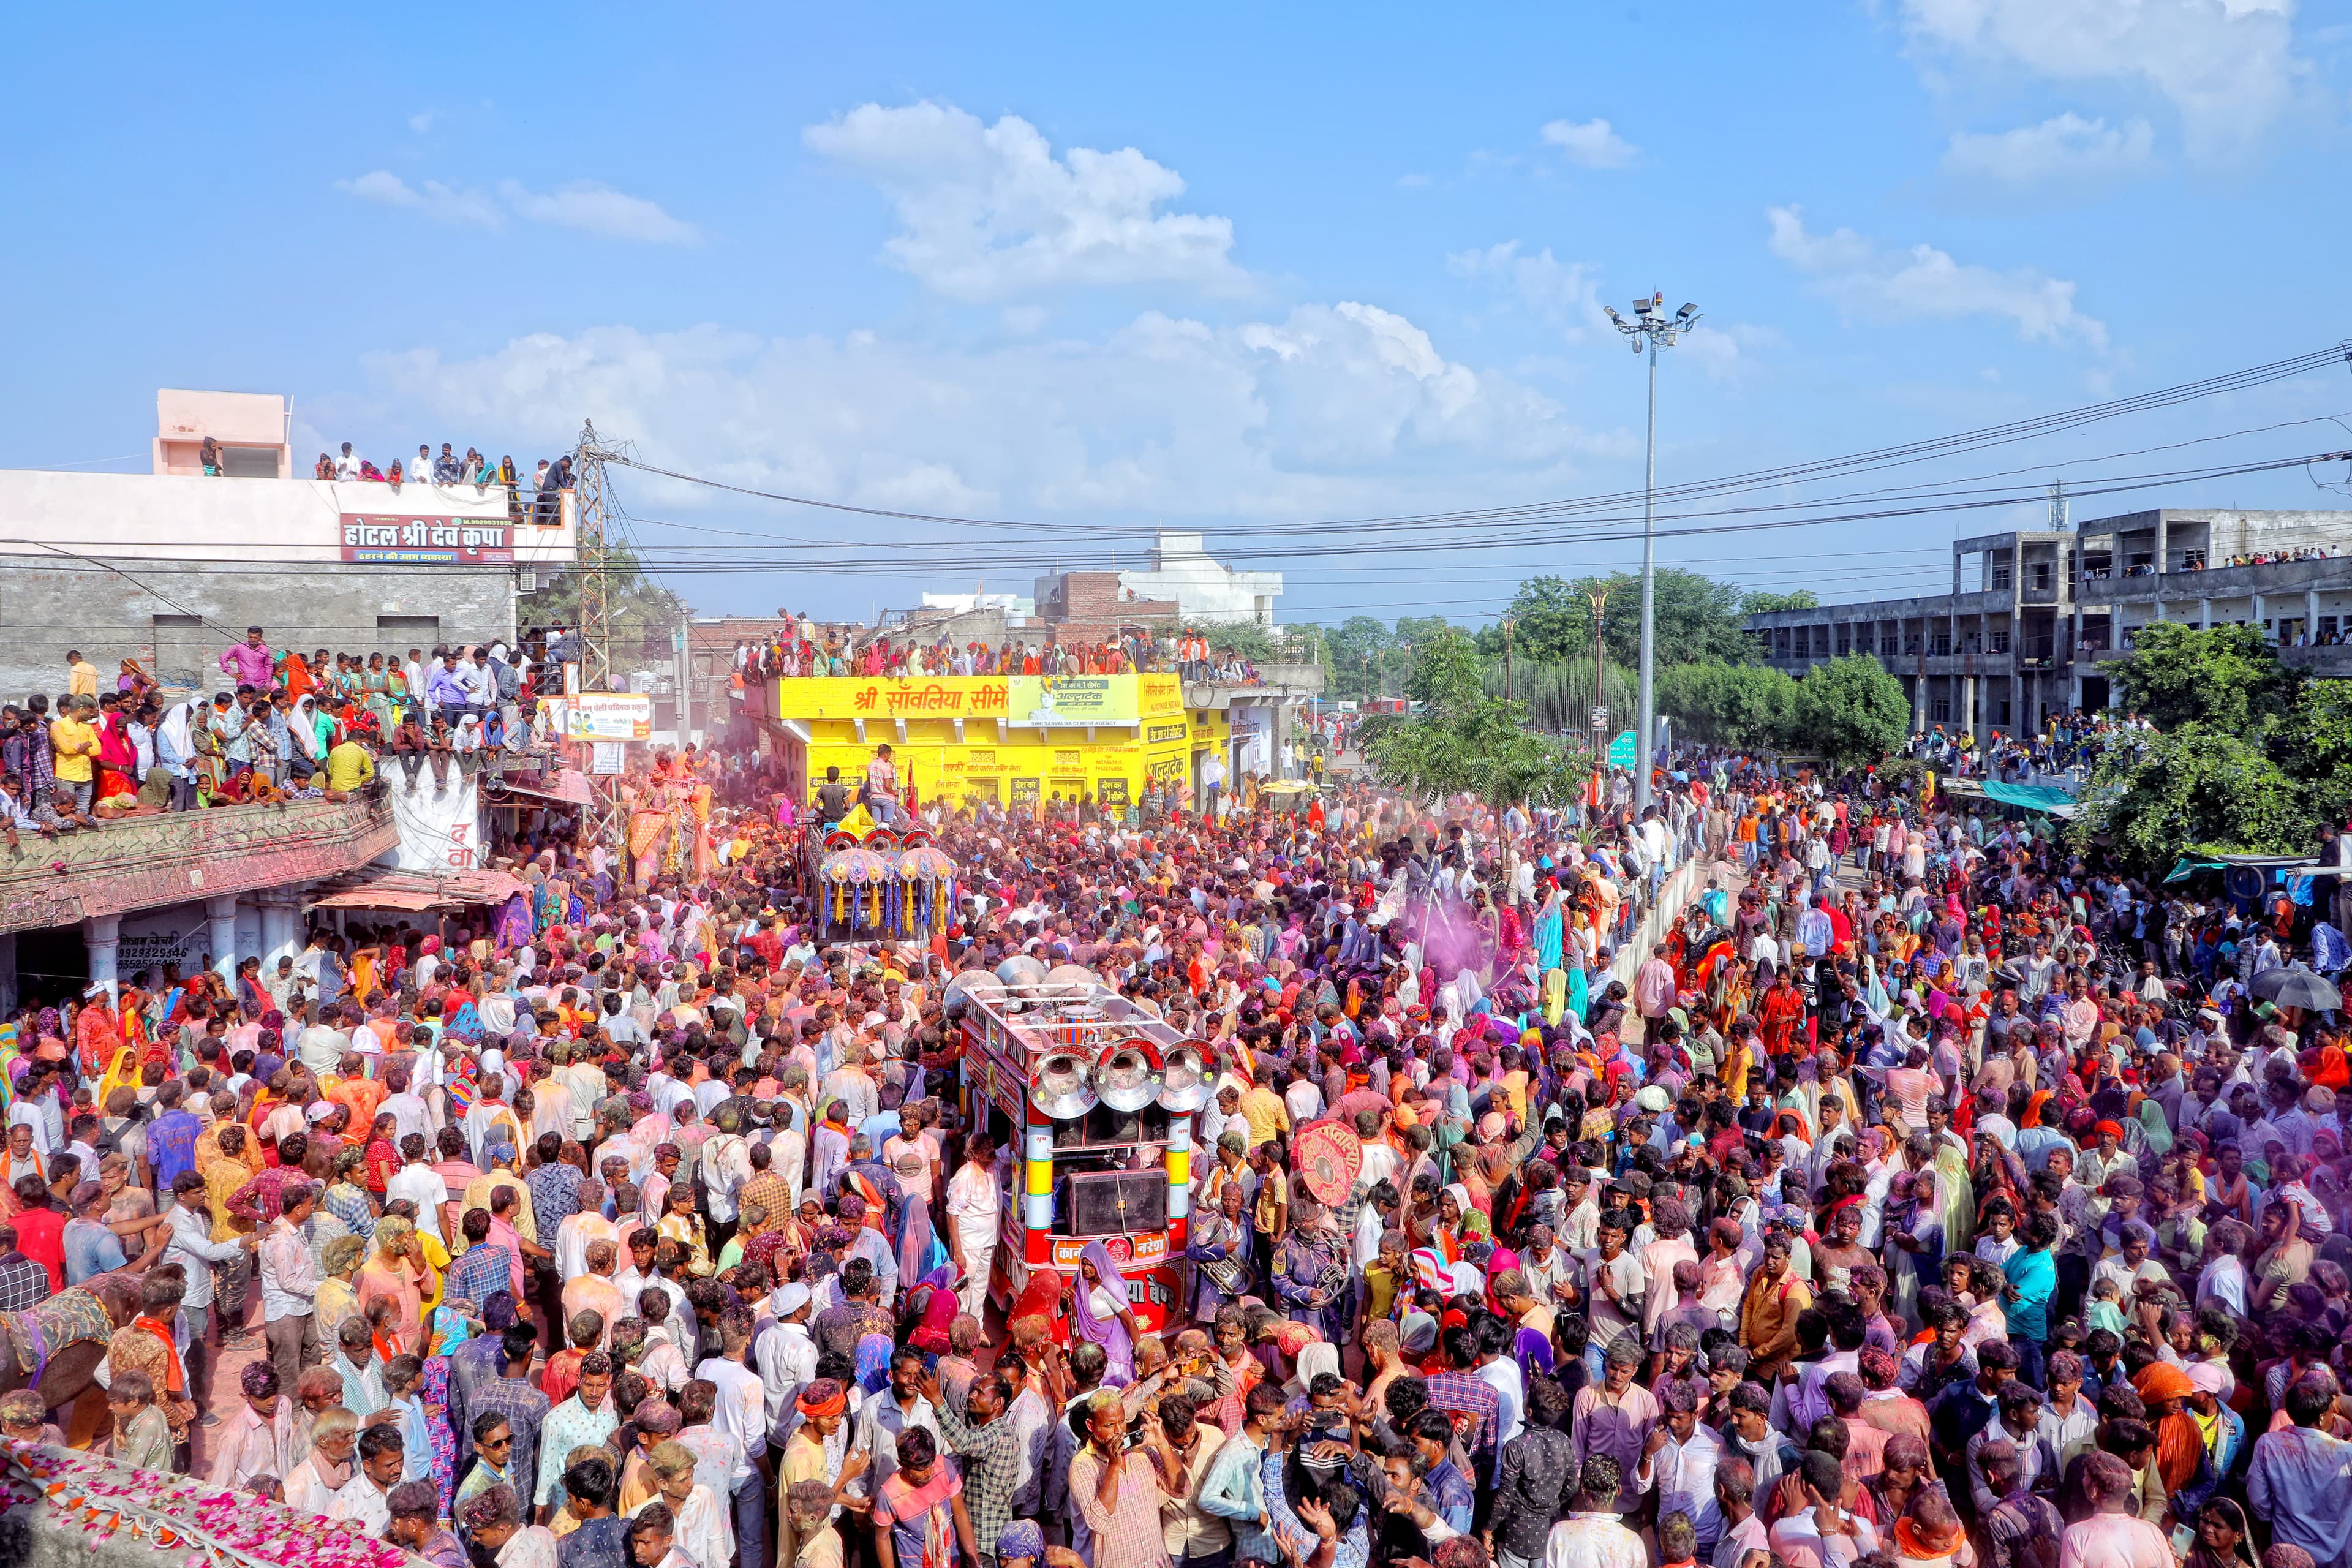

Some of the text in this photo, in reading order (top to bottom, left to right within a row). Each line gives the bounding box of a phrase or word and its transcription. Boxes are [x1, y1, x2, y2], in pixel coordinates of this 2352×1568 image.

[343, 518, 505, 556] होटल श्री देव कृपा
[385, 552, 398, 560] की
[854, 683, 1009, 710] श्री साँवलिया सीमें
[1014, 780, 1026, 789] देश
[1102, 780, 1113, 789] देश
[1008, 1035, 1025, 1068] BAND
[1137, 1238, 1164, 1254] नरेश
[1146, 1273, 1175, 1311] बैण्ड
